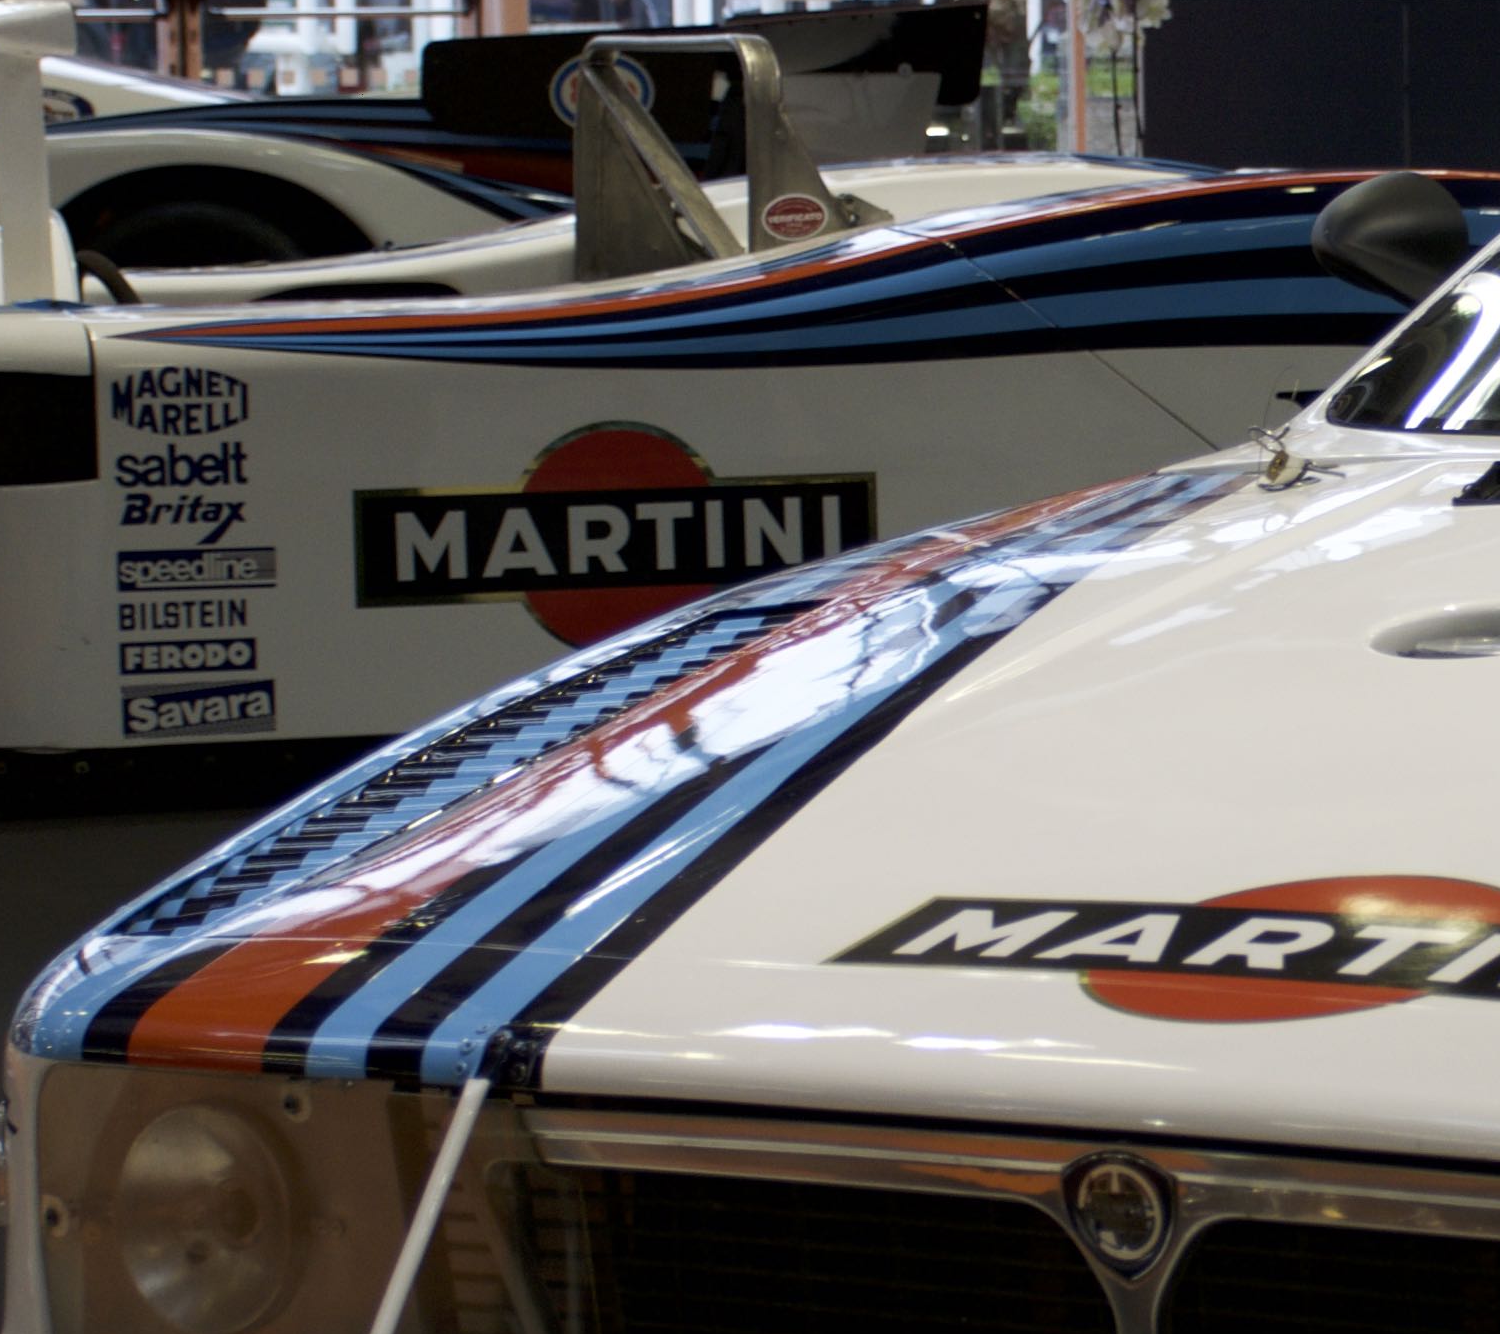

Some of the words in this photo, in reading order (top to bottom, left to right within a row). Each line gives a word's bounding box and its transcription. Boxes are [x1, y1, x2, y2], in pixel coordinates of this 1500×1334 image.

[111, 365, 248, 409] MAGNETI
[111, 399, 248, 436] MARELLI
[115, 441, 247, 487] sabelt
[120, 493, 247, 545] Britax
[393, 494, 842, 583] MARTINI
[118, 551, 259, 588] speedline
[119, 598, 248, 631] BILSTEIN
[124, 641, 251, 671] FERODO
[127, 689, 271, 733] Savara
